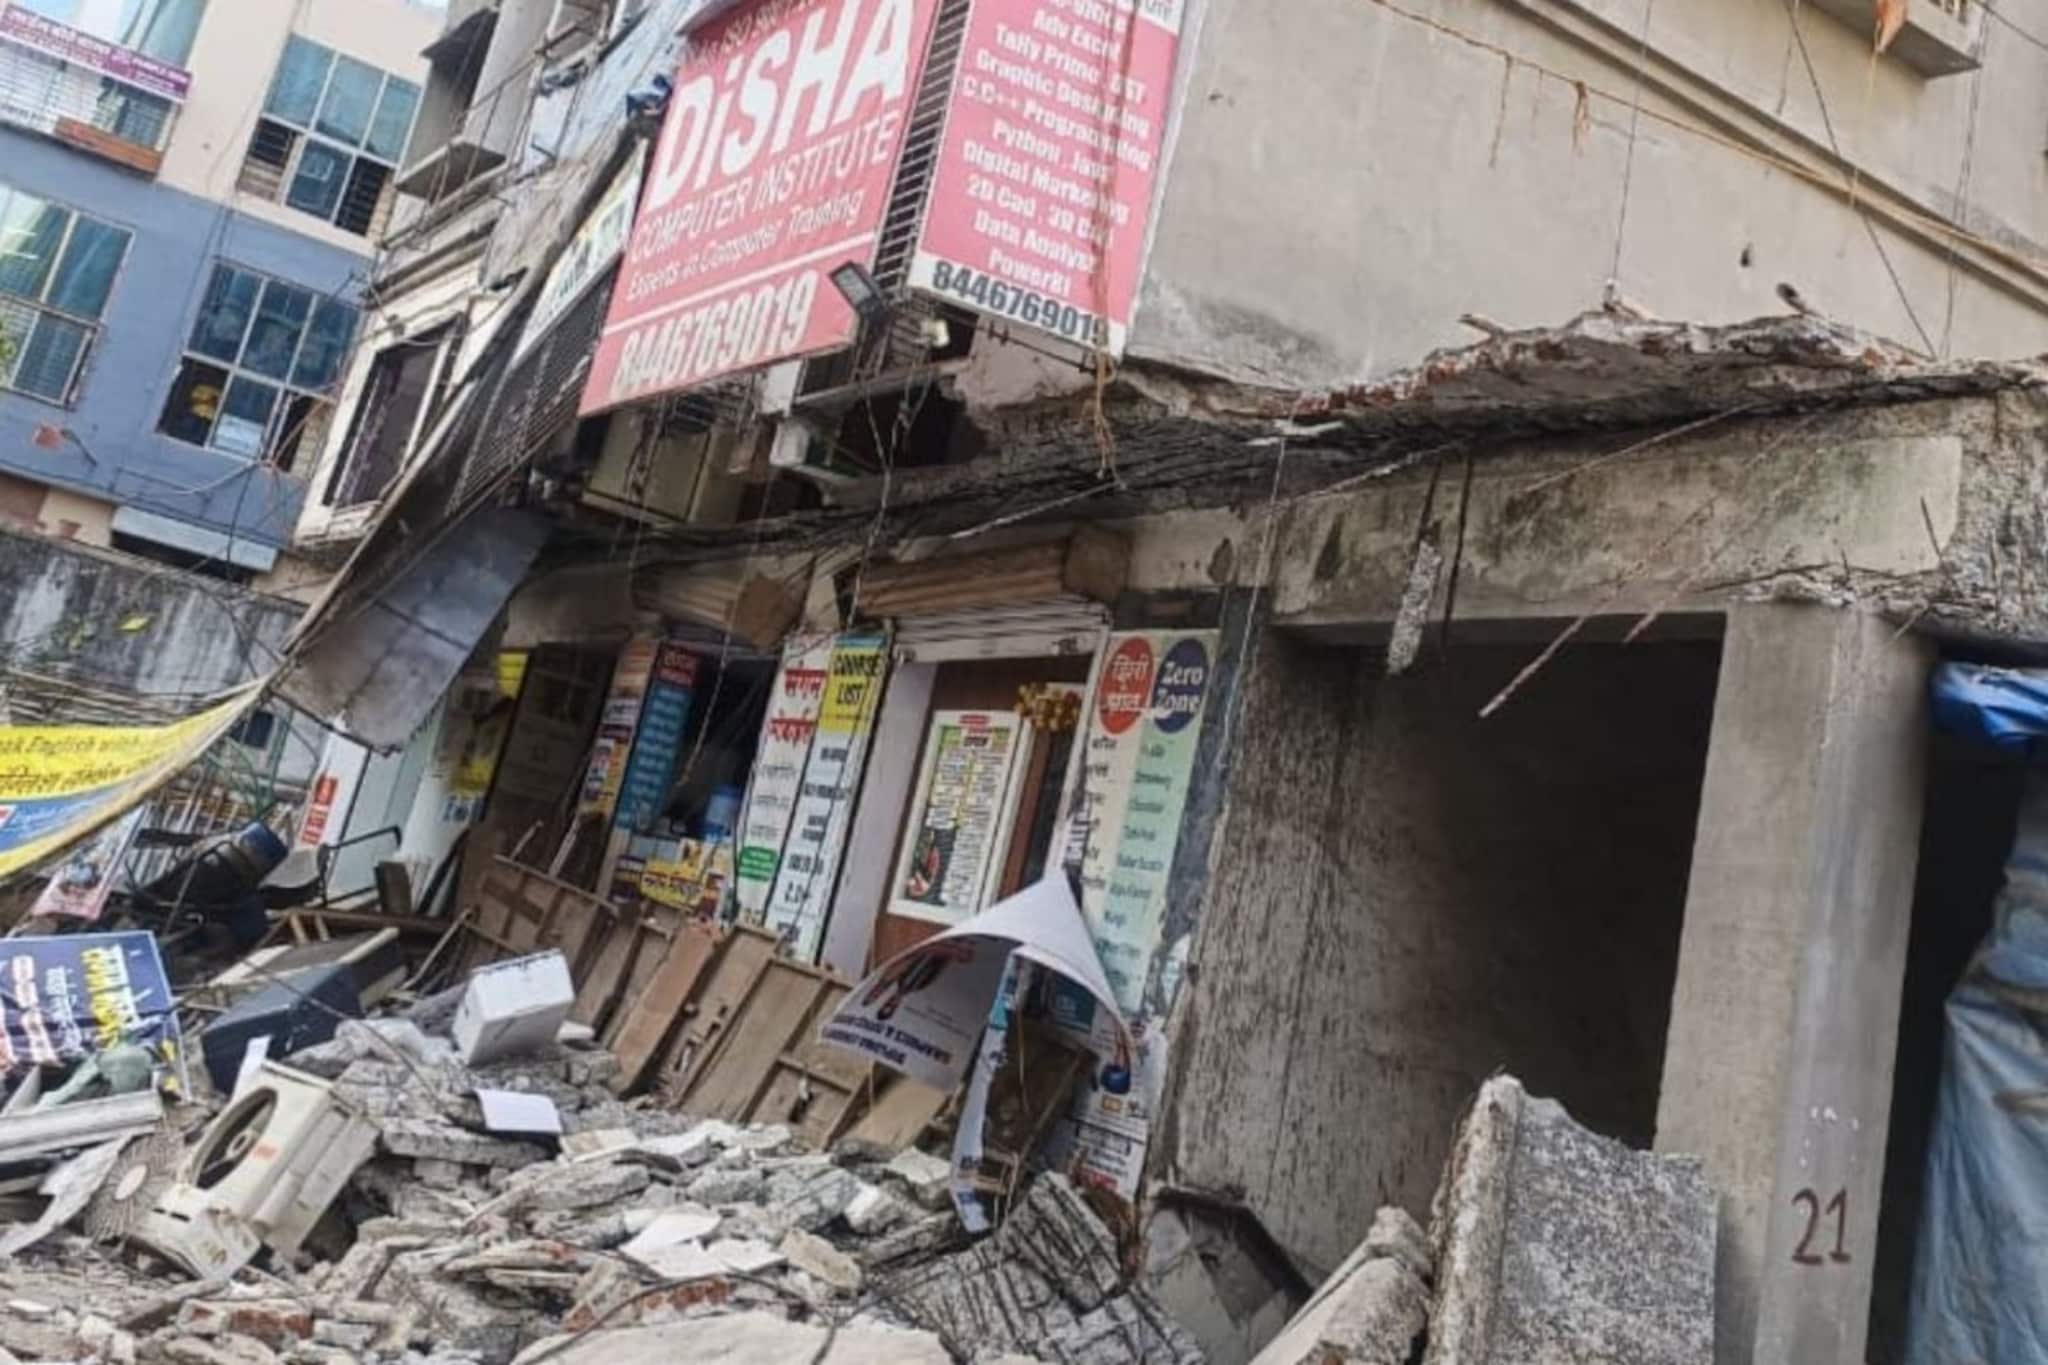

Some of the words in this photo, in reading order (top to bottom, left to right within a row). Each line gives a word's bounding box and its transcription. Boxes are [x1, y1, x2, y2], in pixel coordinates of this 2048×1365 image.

[996, 24, 1041, 61] Tally
[1033, 9, 1067, 39] Adv
[977, 48, 1054, 94] Graphic
[963, 139, 1029, 182] Digital
[992, 118, 1061, 163] Python
[630, 178, 752, 263] COMPUTER
[751, 112, 898, 212] INSTITUTE
[788, 188, 866, 237] Training
[974, 208, 1021, 246] Data
[932, 260, 1109, 345] 8446769019
[610, 269, 818, 399] 8446769019
[1162, 661, 1204, 686] Zero
[1155, 688, 1199, 714] Zone
[1791, 1186, 1851, 1265] 21
